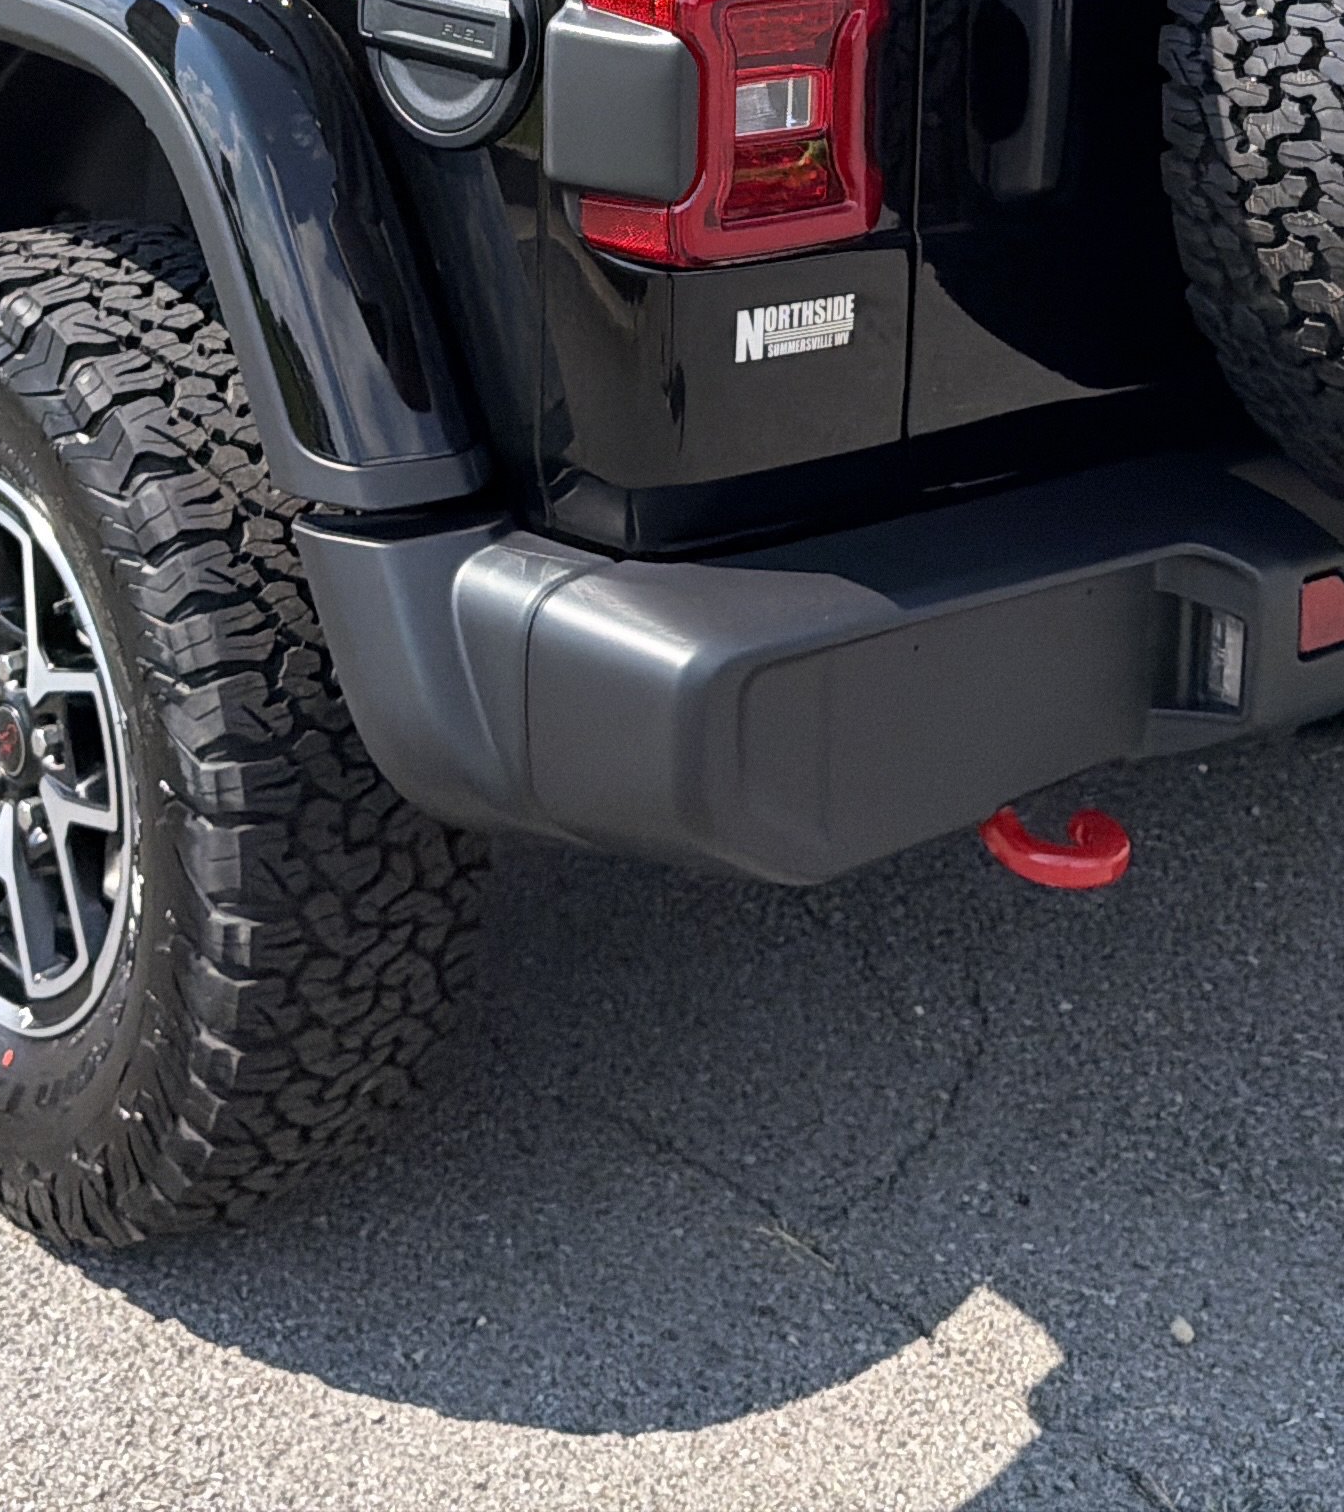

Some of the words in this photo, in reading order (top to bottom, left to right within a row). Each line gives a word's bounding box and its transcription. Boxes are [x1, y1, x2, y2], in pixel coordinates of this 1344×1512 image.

[735, 294, 855, 363] NORTHSIDE
[767, 334, 833, 358] SUMMERSVILLE
[834, 331, 850, 345] WV
